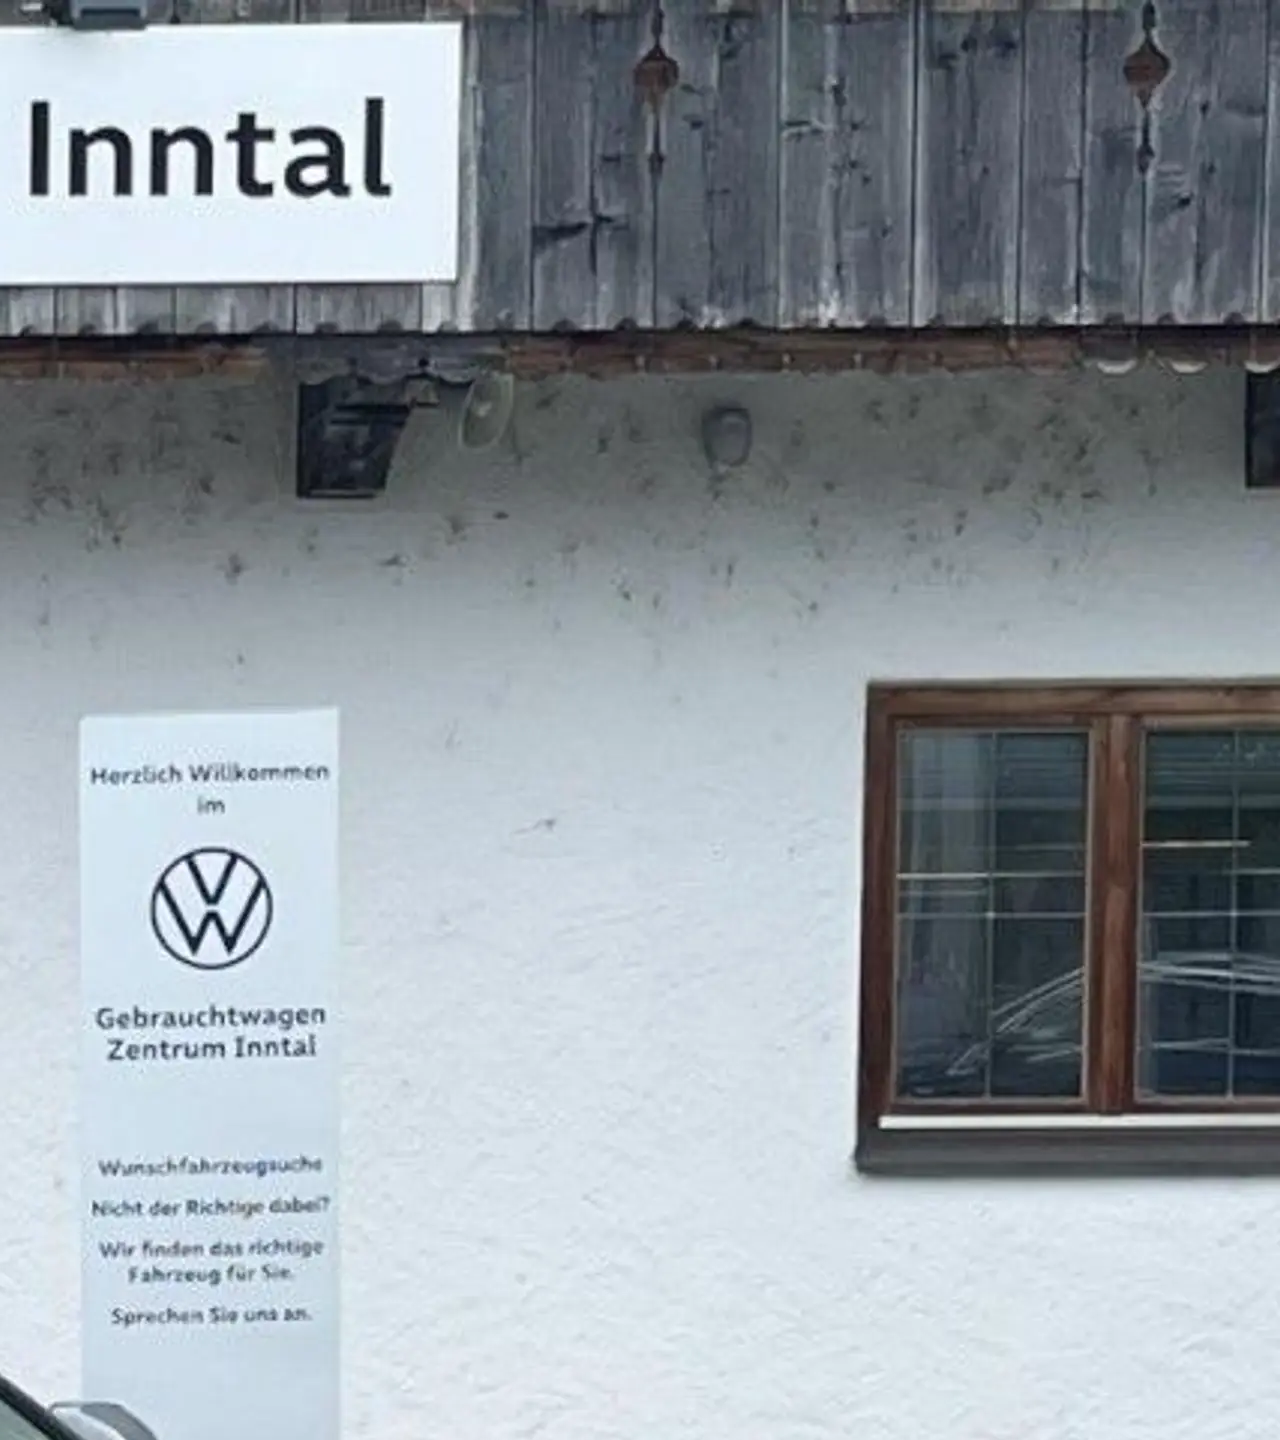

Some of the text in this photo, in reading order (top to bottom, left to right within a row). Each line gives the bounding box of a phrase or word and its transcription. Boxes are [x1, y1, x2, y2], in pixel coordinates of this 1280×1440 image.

[28, 96, 393, 199] Inntal
[90, 762, 331, 786] Herzlich Willkommen
[196, 797, 227, 815] im
[95, 1004, 327, 1032] Gebrauchtwagen
[107, 1034, 318, 1063] Zentrum Inntal
[98, 1154, 324, 1178] Wunschfahrzeugsuche
[91, 1195, 331, 1219] Nicht der Richtige dabei?
[98, 1238, 325, 1259] Wir finden das richtige
[127, 1265, 223, 1286] Fahrzeug
[226, 1264, 258, 1282] für
[111, 1306, 205, 1328] Sprechen
[208, 1306, 240, 1323] Sie
[243, 1307, 280, 1322] uns
